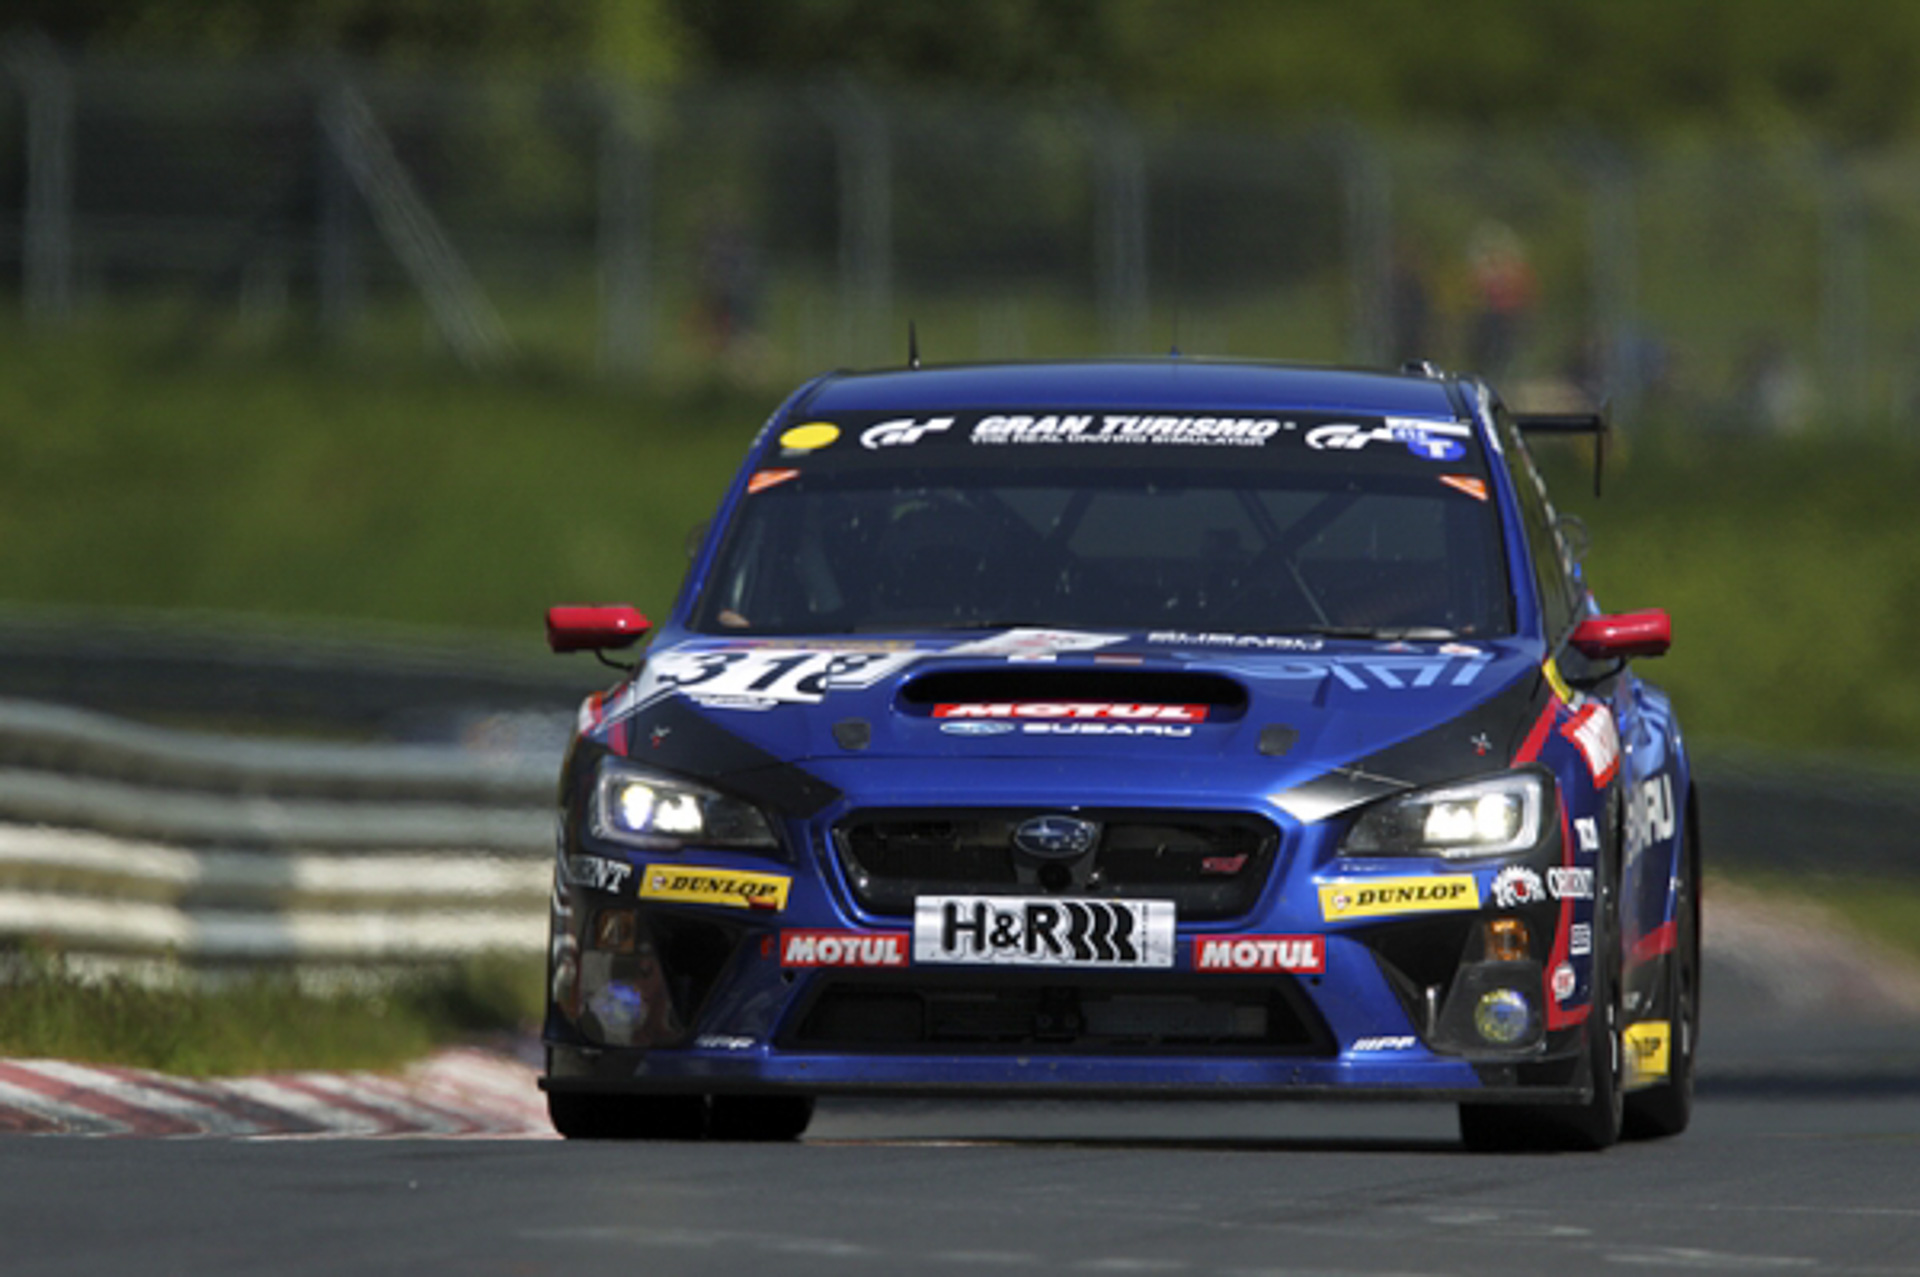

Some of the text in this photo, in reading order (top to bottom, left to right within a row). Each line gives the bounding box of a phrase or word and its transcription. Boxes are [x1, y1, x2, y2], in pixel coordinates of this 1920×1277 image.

[975, 415, 1280, 438] GRAN TURISMO
[655, 651, 890, 696] 318
[944, 703, 1197, 718] MOTUL
[1022, 722, 1192, 737] SUBARU
[670, 875, 778, 898] DUNLOP
[1355, 883, 1467, 907] DUNLOP
[785, 935, 903, 963] MOTUL
[1199, 939, 1319, 968] MOTUL
